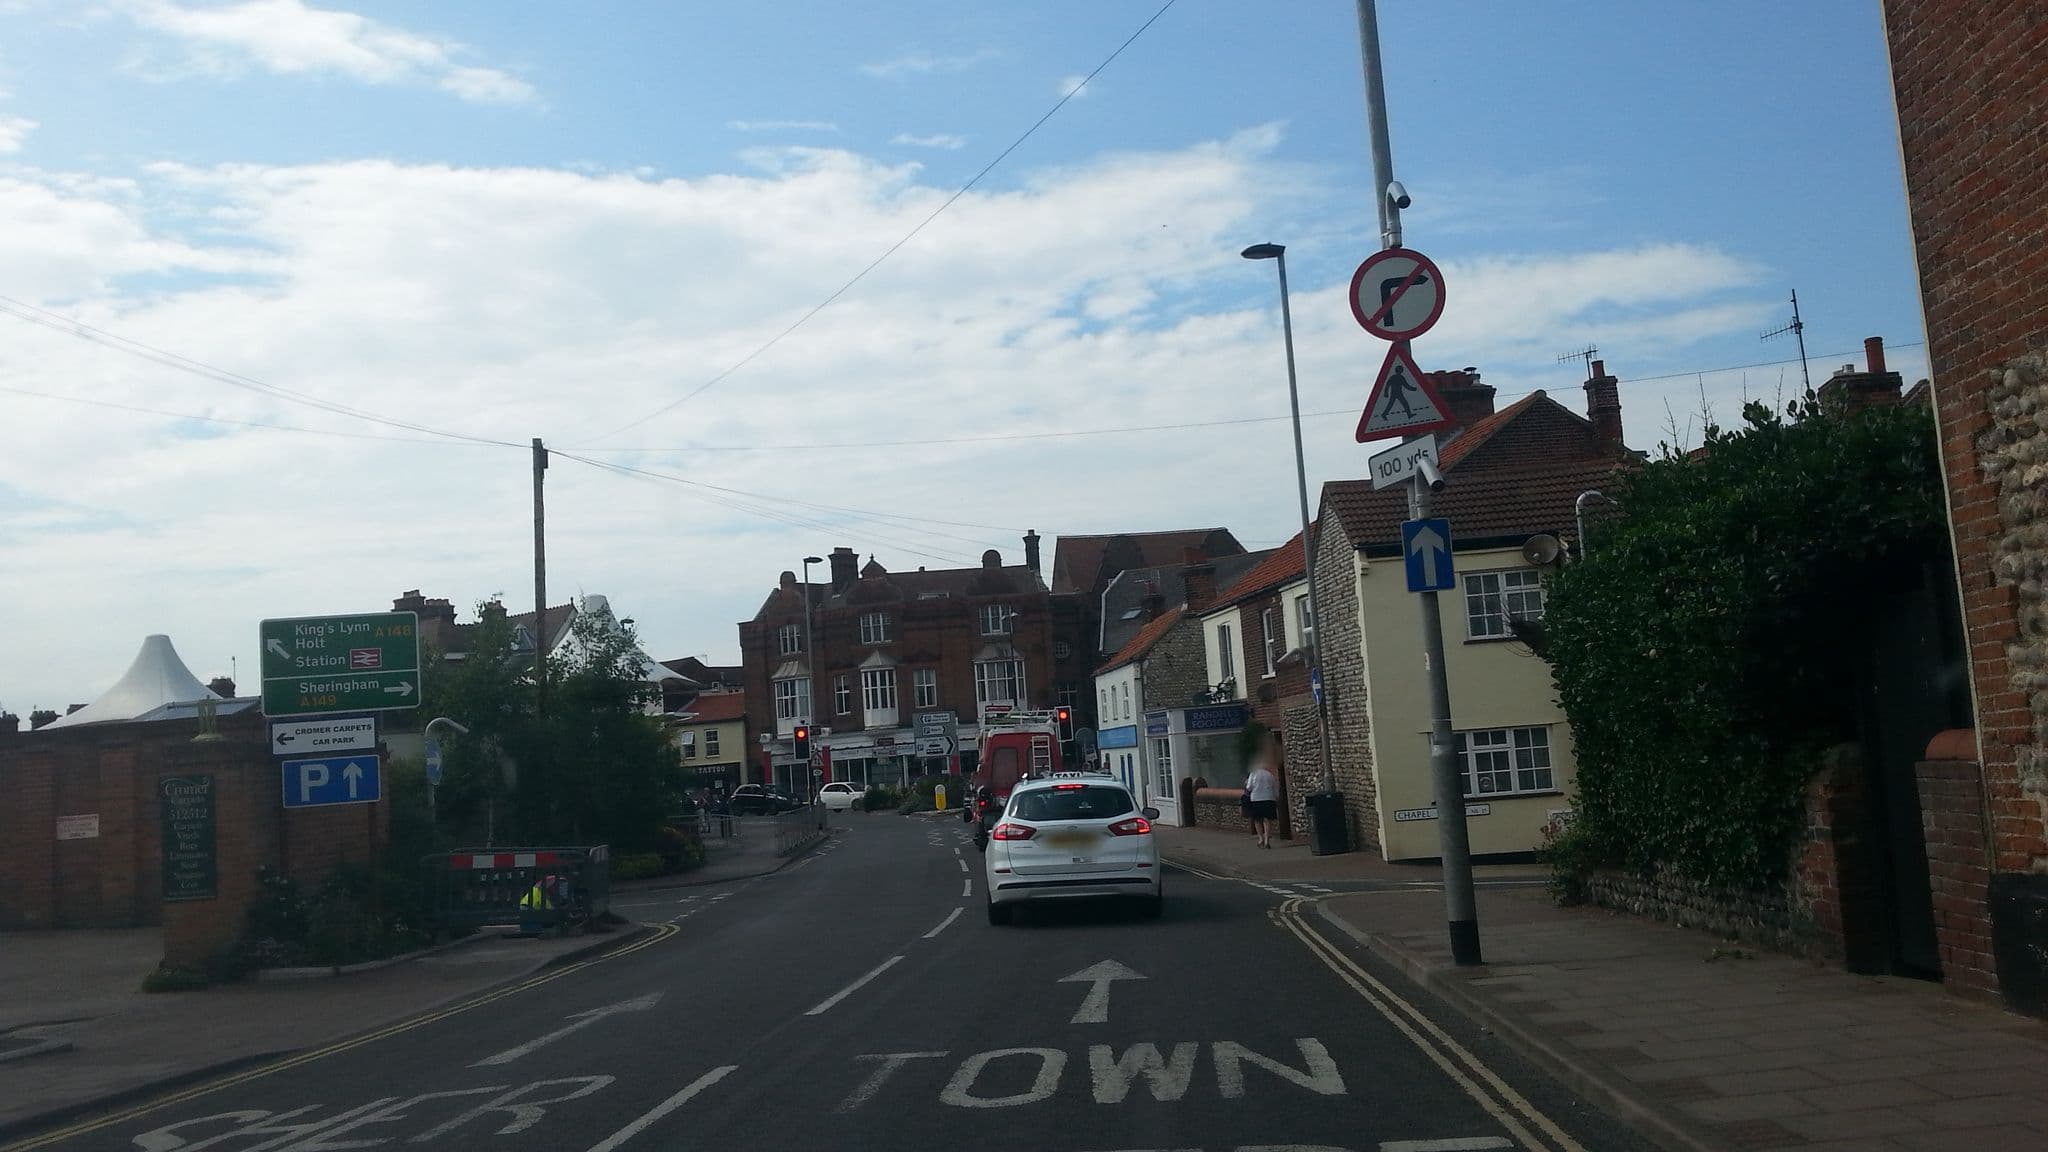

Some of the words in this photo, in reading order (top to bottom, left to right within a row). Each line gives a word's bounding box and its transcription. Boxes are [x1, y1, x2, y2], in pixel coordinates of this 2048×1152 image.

[1378, 458, 1402, 478] 100
[1407, 448, 1429, 470] yds
[295, 623, 335, 637] King's
[340, 622, 370, 633] Lynn
[296, 638, 325, 649] Holt
[296, 655, 346, 667] Station
[300, 680, 379, 694] Sheringham
[295, 727, 330, 735] CROMER
[333, 724, 372, 733] CARPETS
[332, 736, 355, 744] PARK
[698, 766, 726, 774] TATTOO
[300, 764, 329, 802] P
[165, 783, 209, 796] Cromer
[1397, 810, 1431, 819] CHAPEL
[837, 1038, 1347, 1114] TOWN
